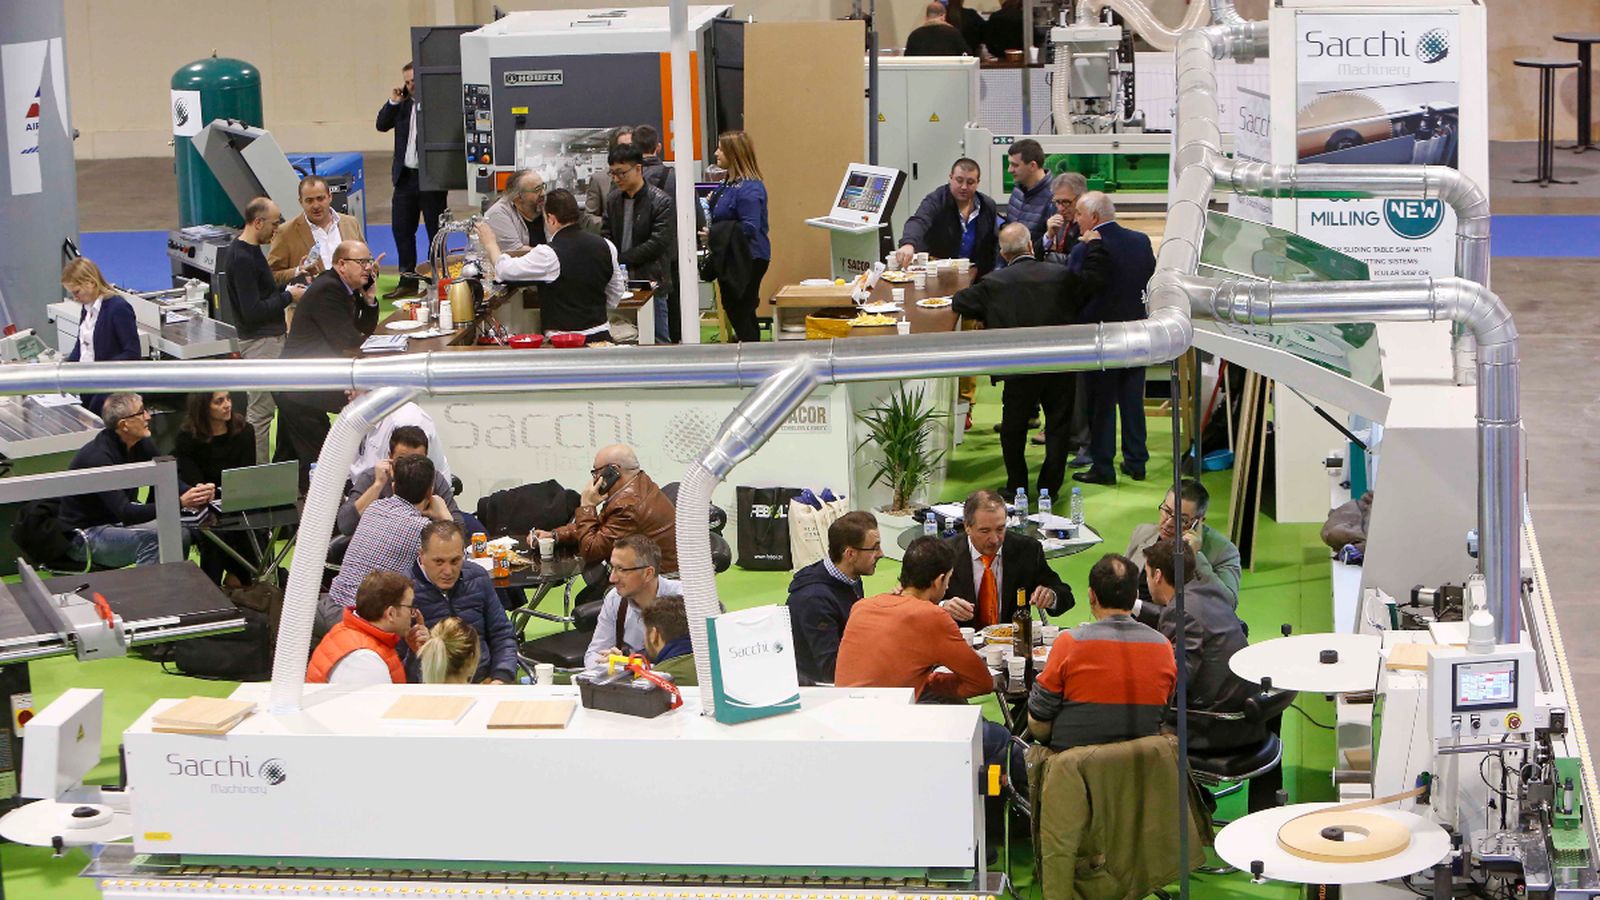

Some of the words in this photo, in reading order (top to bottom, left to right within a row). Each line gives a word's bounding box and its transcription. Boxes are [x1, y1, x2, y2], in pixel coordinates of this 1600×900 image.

[1305, 30, 1410, 57] Sacchi
[1337, 63, 1411, 77] Machinery
[1391, 201, 1437, 218] NEW
[1311, 211, 1380, 226] MILLING
[444, 400, 643, 449] Sacchi
[166, 753, 254, 778] Sacchi
[210, 783, 267, 797] Machinery
